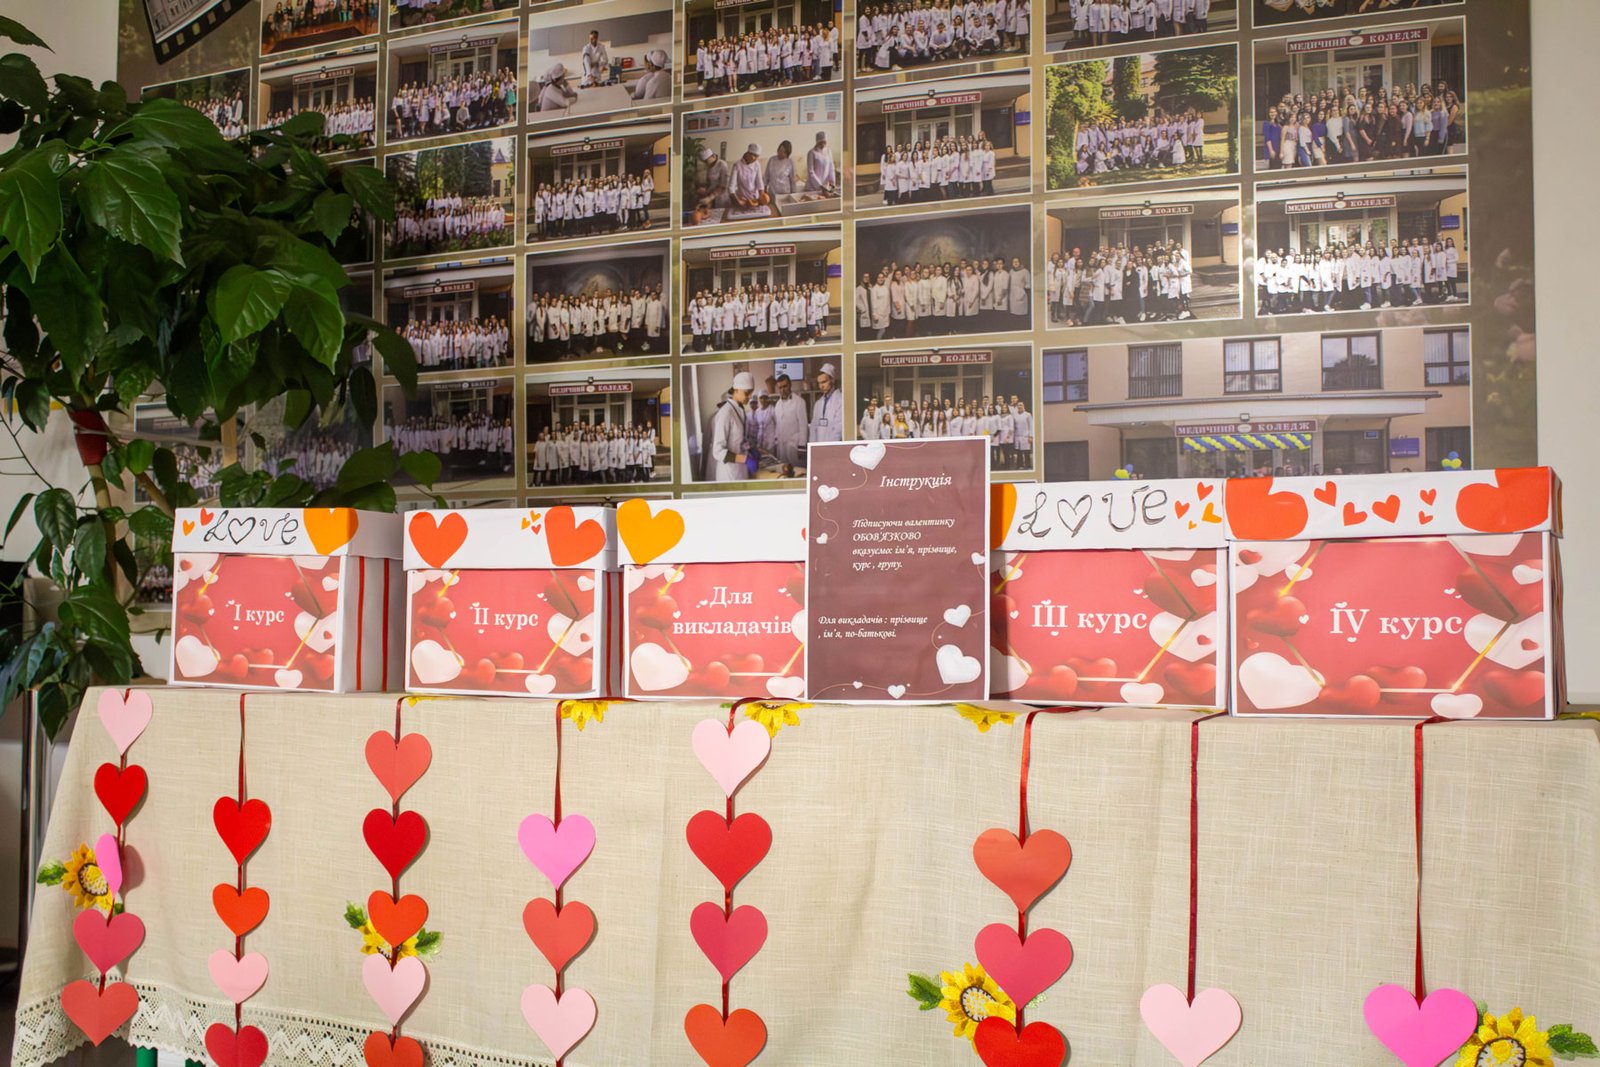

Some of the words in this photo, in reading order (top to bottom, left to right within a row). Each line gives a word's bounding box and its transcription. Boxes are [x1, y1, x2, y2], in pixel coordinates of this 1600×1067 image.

[1288, 37, 1348, 52] МЕДИЧНИЙ
[1369, 31, 1421, 44] КОЛЕДЖ
[884, 100, 925, 111] МЕДИЧНИЙ
[940, 95, 977, 105] КОЛЕДЖ
[1155, 206, 1190, 215] КОЛЕДЖ
[1288, 200, 1334, 212] МЕДИЧНИЙ
[1350, 198, 1391, 208] КОЛЕДЖ
[882, 355, 929, 366] МЕДИЧНИЙ
[945, 353, 988, 363] КОЛЕДЖ
[1177, 423, 1236, 435] МЕДИЧНИЙ
[1258, 421, 1311, 432] КОЛЕДЖ
[879, 472, 953, 491] Інструкція
[852, 518, 903, 530] Підписуючи
[904, 518, 956, 531] валентинку
[917, 545, 958, 557] прізвище,
[852, 562, 872, 572] курс
[877, 561, 903, 572] групу.
[709, 585, 754, 609] Для
[245, 609, 286, 626] курс
[493, 612, 540, 630] курс
[818, 615, 836, 625] Для
[837, 614, 883, 626] викладачів
[889, 615, 928, 627] прізвище
[1076, 612, 1149, 635] курс
[672, 615, 792, 637] викладачів
[1378, 616, 1463, 641] курс
